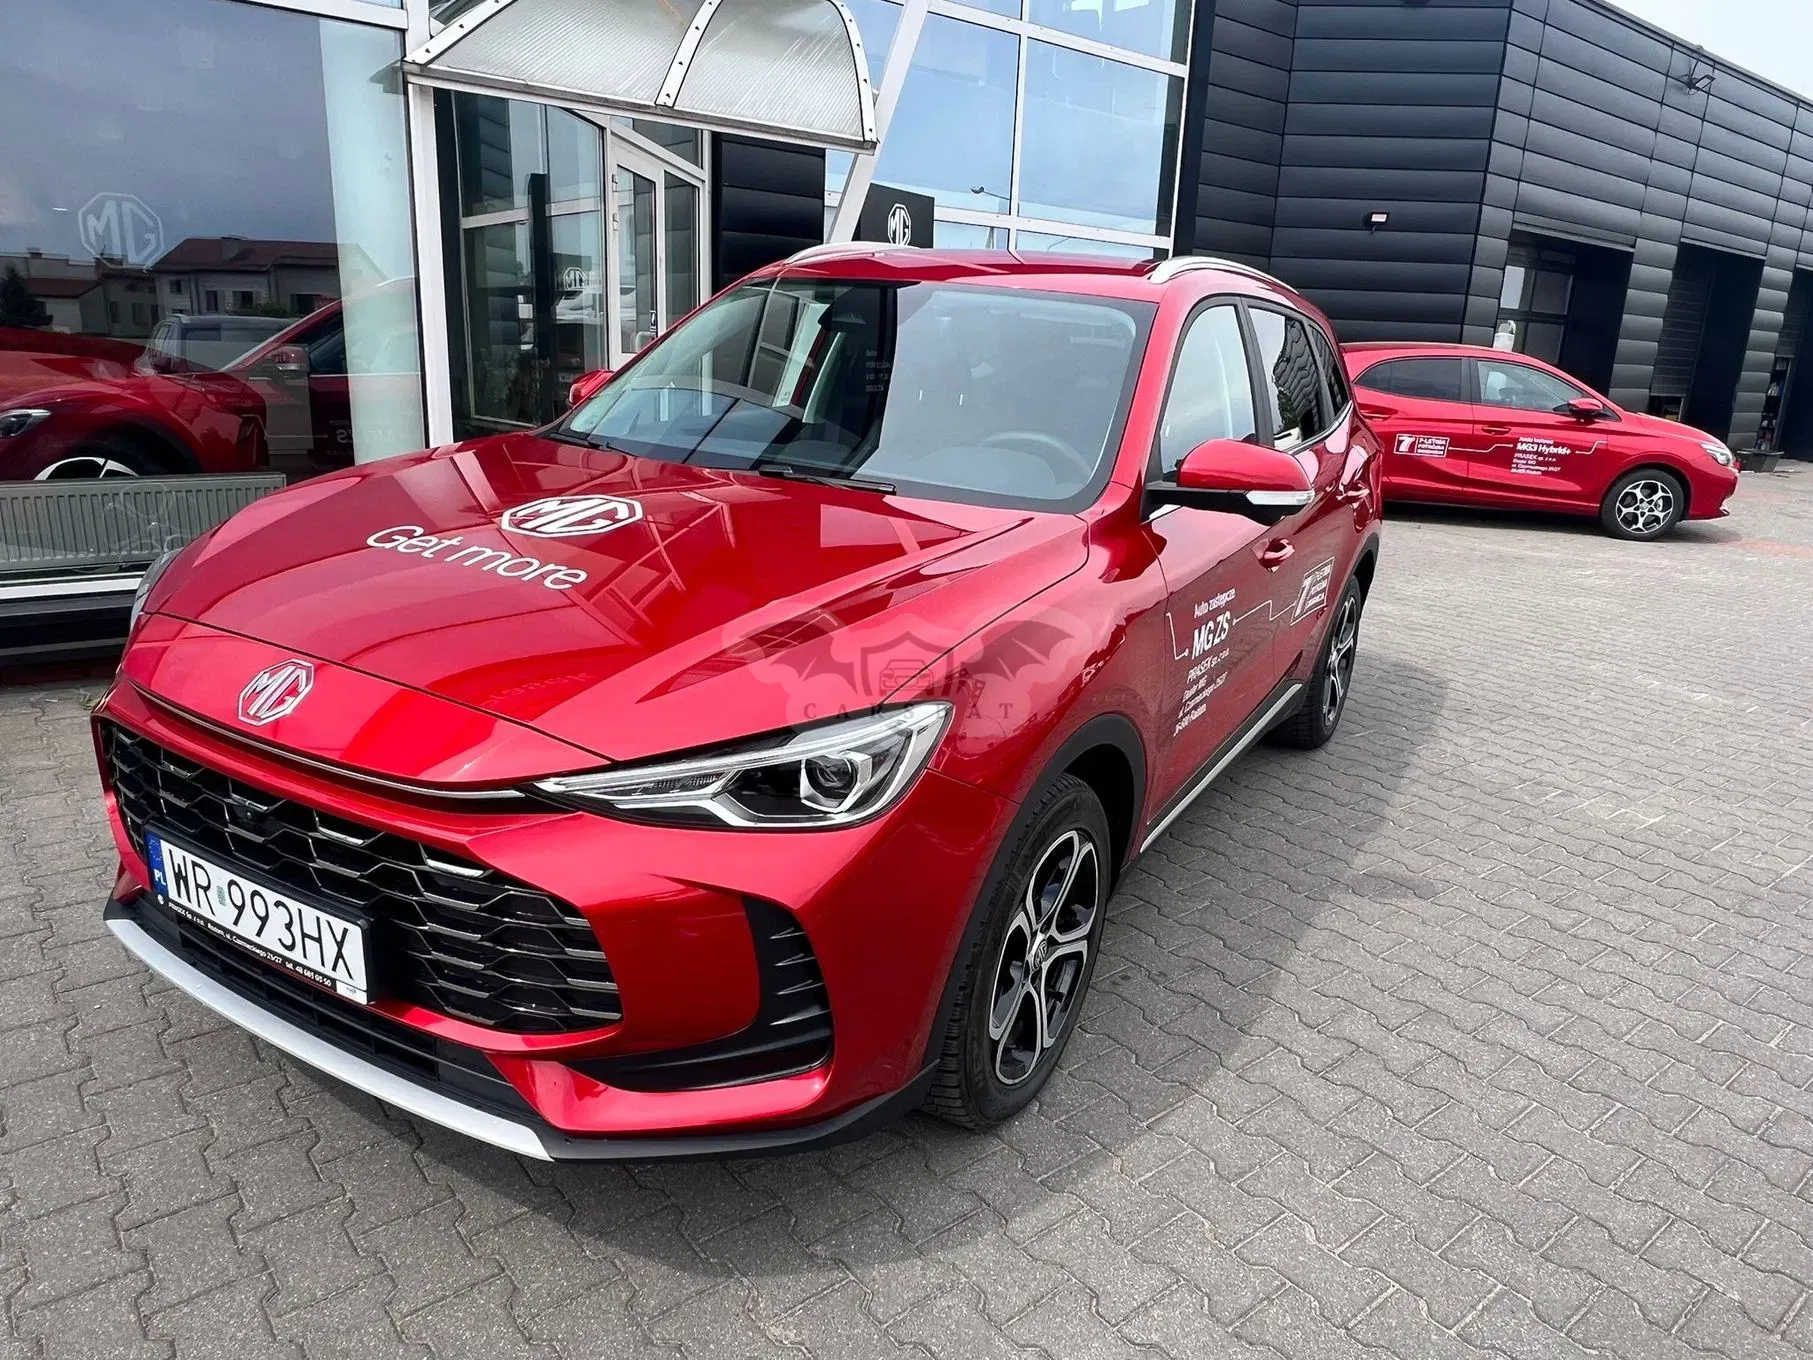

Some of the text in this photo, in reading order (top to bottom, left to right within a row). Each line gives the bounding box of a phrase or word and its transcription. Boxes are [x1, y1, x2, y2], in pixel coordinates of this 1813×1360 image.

[85, 198, 157, 264] MG
[888, 204, 911, 246] MG
[1398, 436, 1416, 452] 7
[1516, 442, 1572, 456] MG3 Hybrid+
[510, 498, 632, 533] MG
[366, 525, 588, 590] Get more
[1191, 610, 1231, 660] MG ZS
[243, 664, 307, 719] MG
[154, 869, 167, 886] PL
[169, 849, 355, 981] WR 993HX
